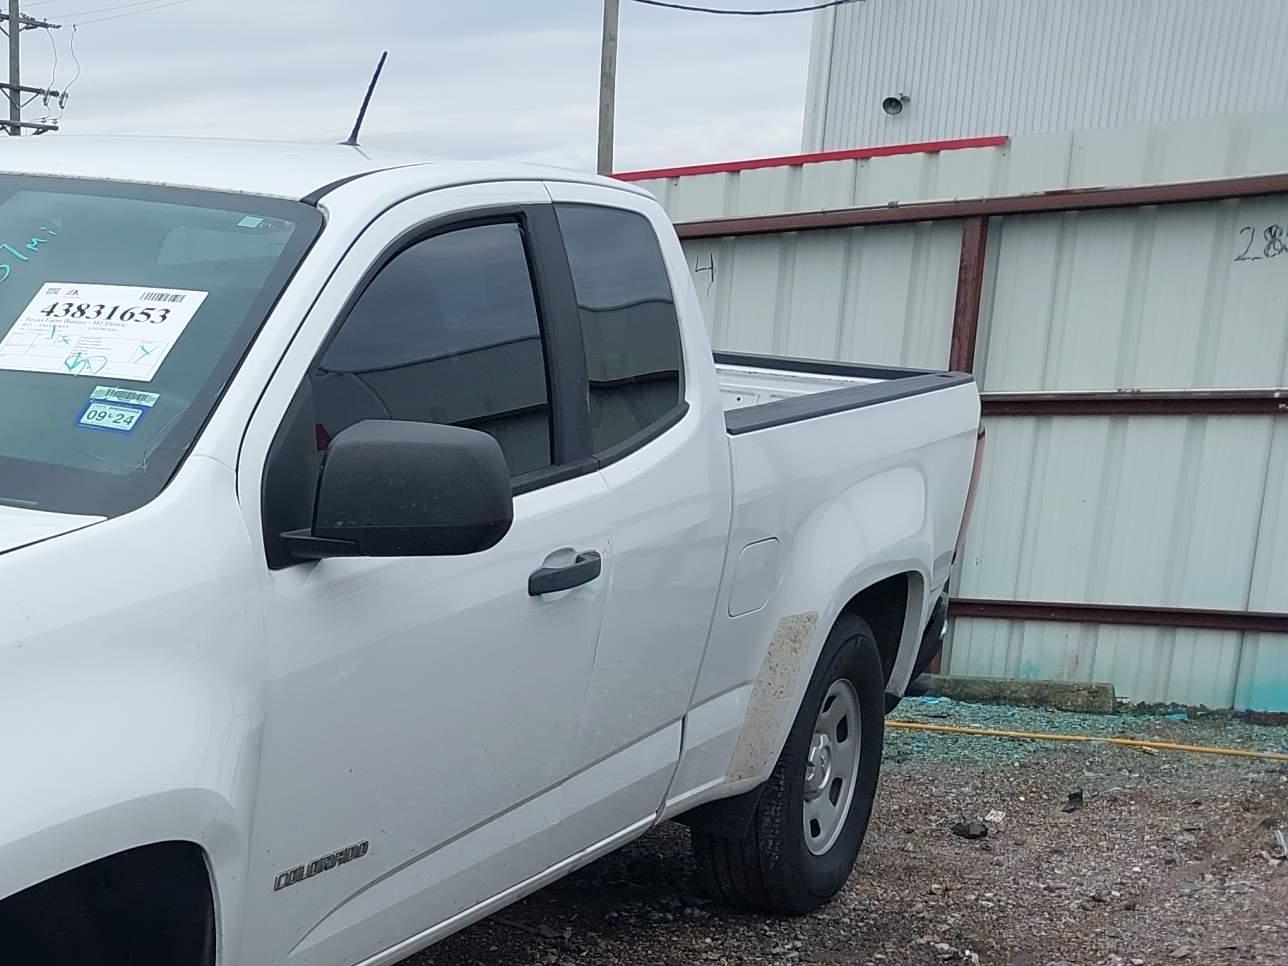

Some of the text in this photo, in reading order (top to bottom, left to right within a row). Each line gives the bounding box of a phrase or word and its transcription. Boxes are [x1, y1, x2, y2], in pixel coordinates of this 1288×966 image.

[40, 301, 171, 324] 43831653
[86, 409, 108, 422] 09
[112, 413, 135, 426] 24
[274, 840, 369, 891] COLORADO
